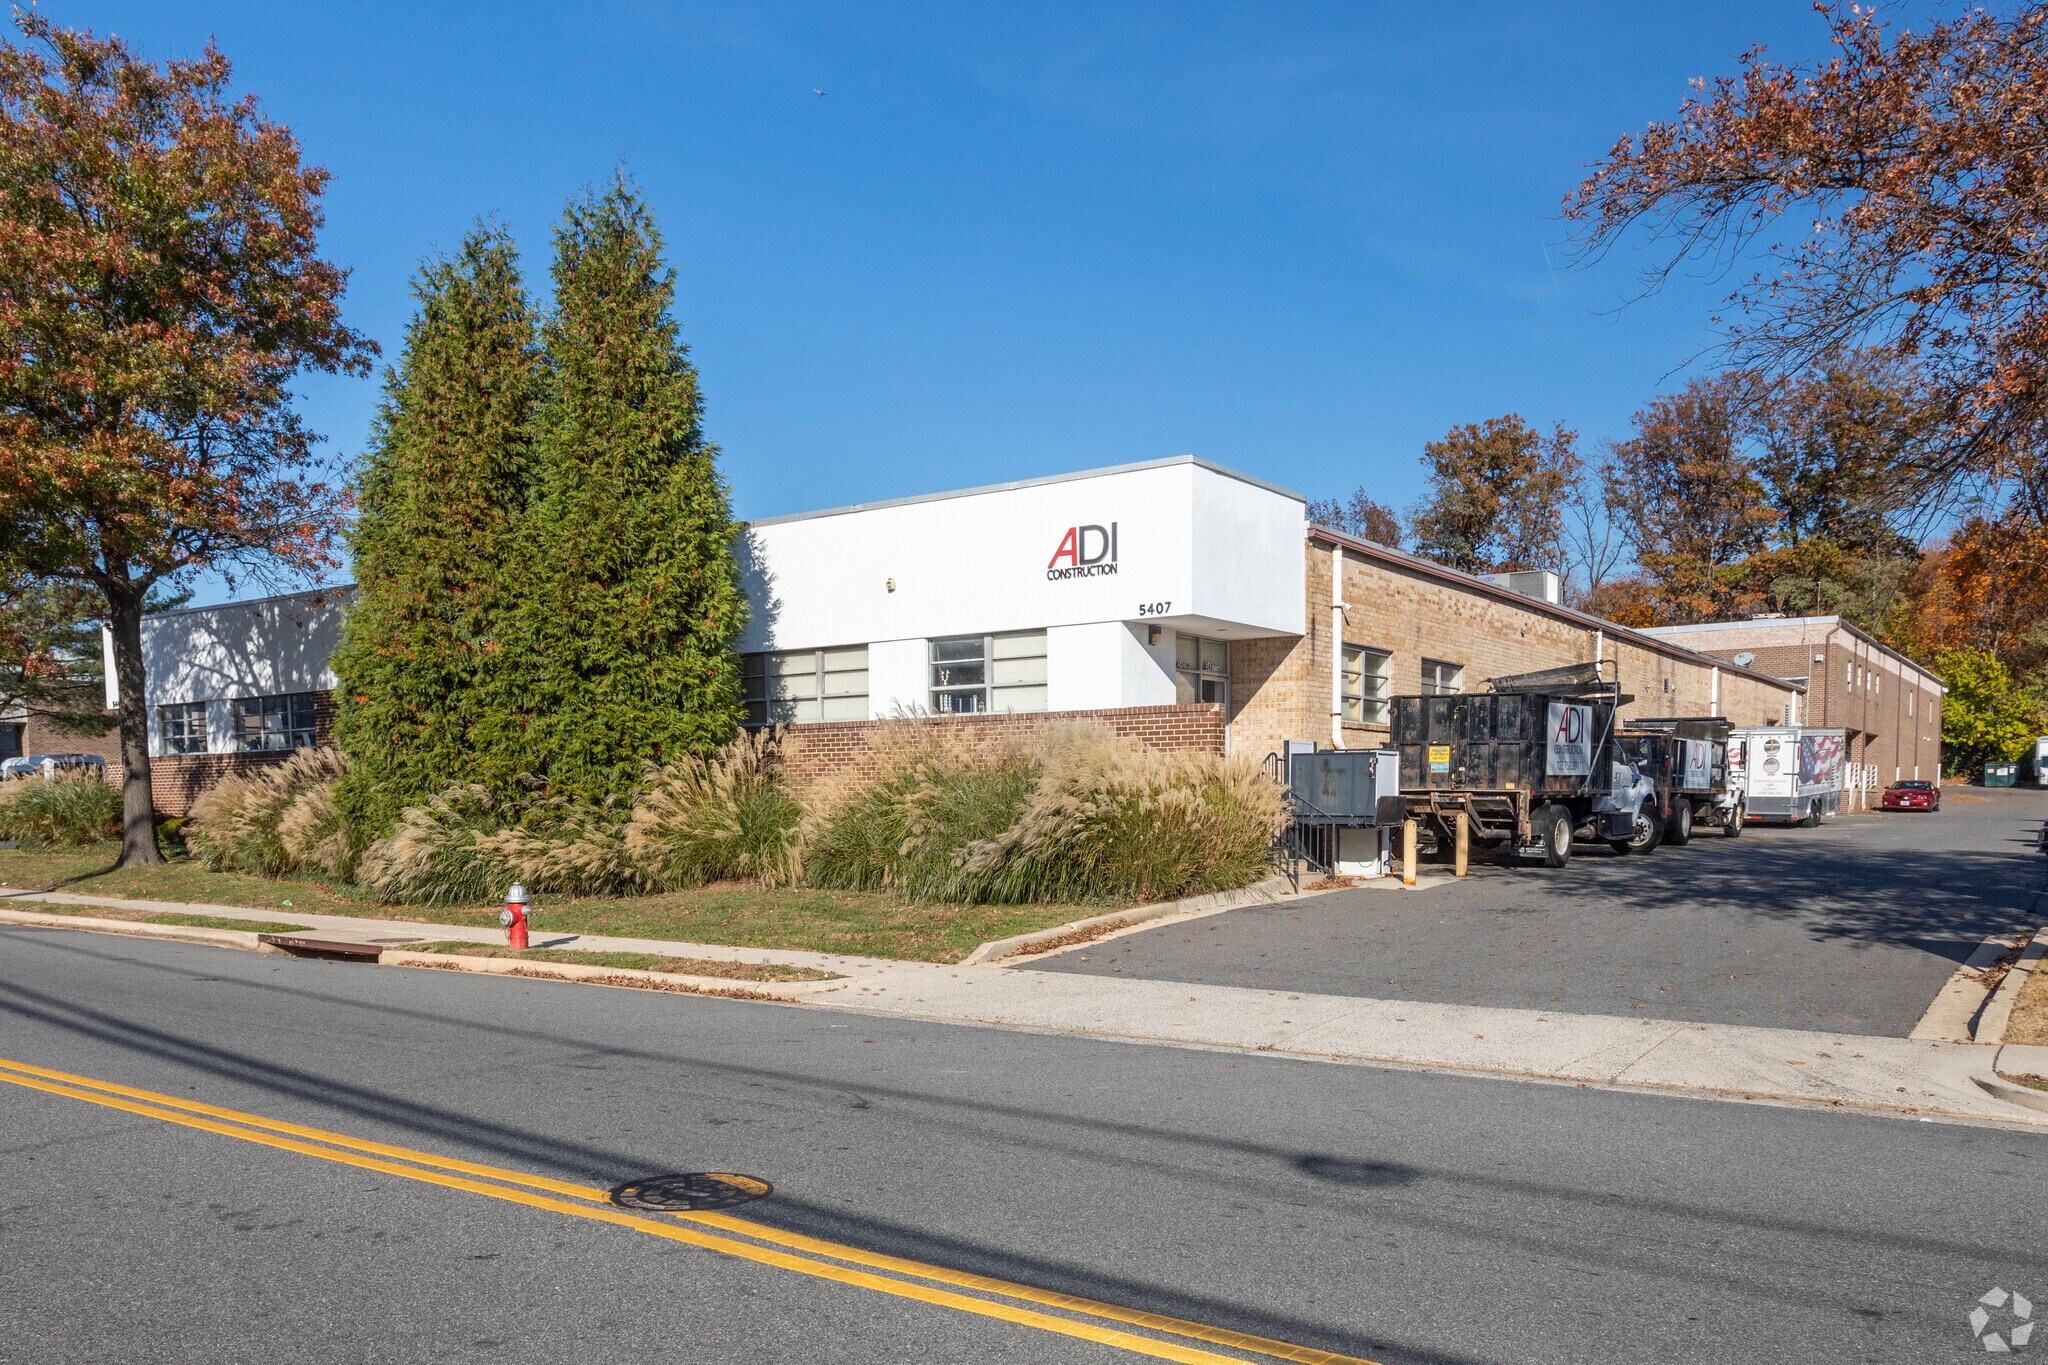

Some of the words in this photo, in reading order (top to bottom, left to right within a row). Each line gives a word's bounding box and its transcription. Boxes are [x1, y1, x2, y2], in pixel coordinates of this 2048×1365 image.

[1048, 522, 1118, 569] ADI
[1047, 563, 1118, 581] CONSTRUCTION
[1139, 602, 1172, 616] 5407
[1555, 706, 1584, 744] ADI
[1554, 744, 1584, 755] CONSTRUCTION
[1690, 743, 1706, 770] ADI
